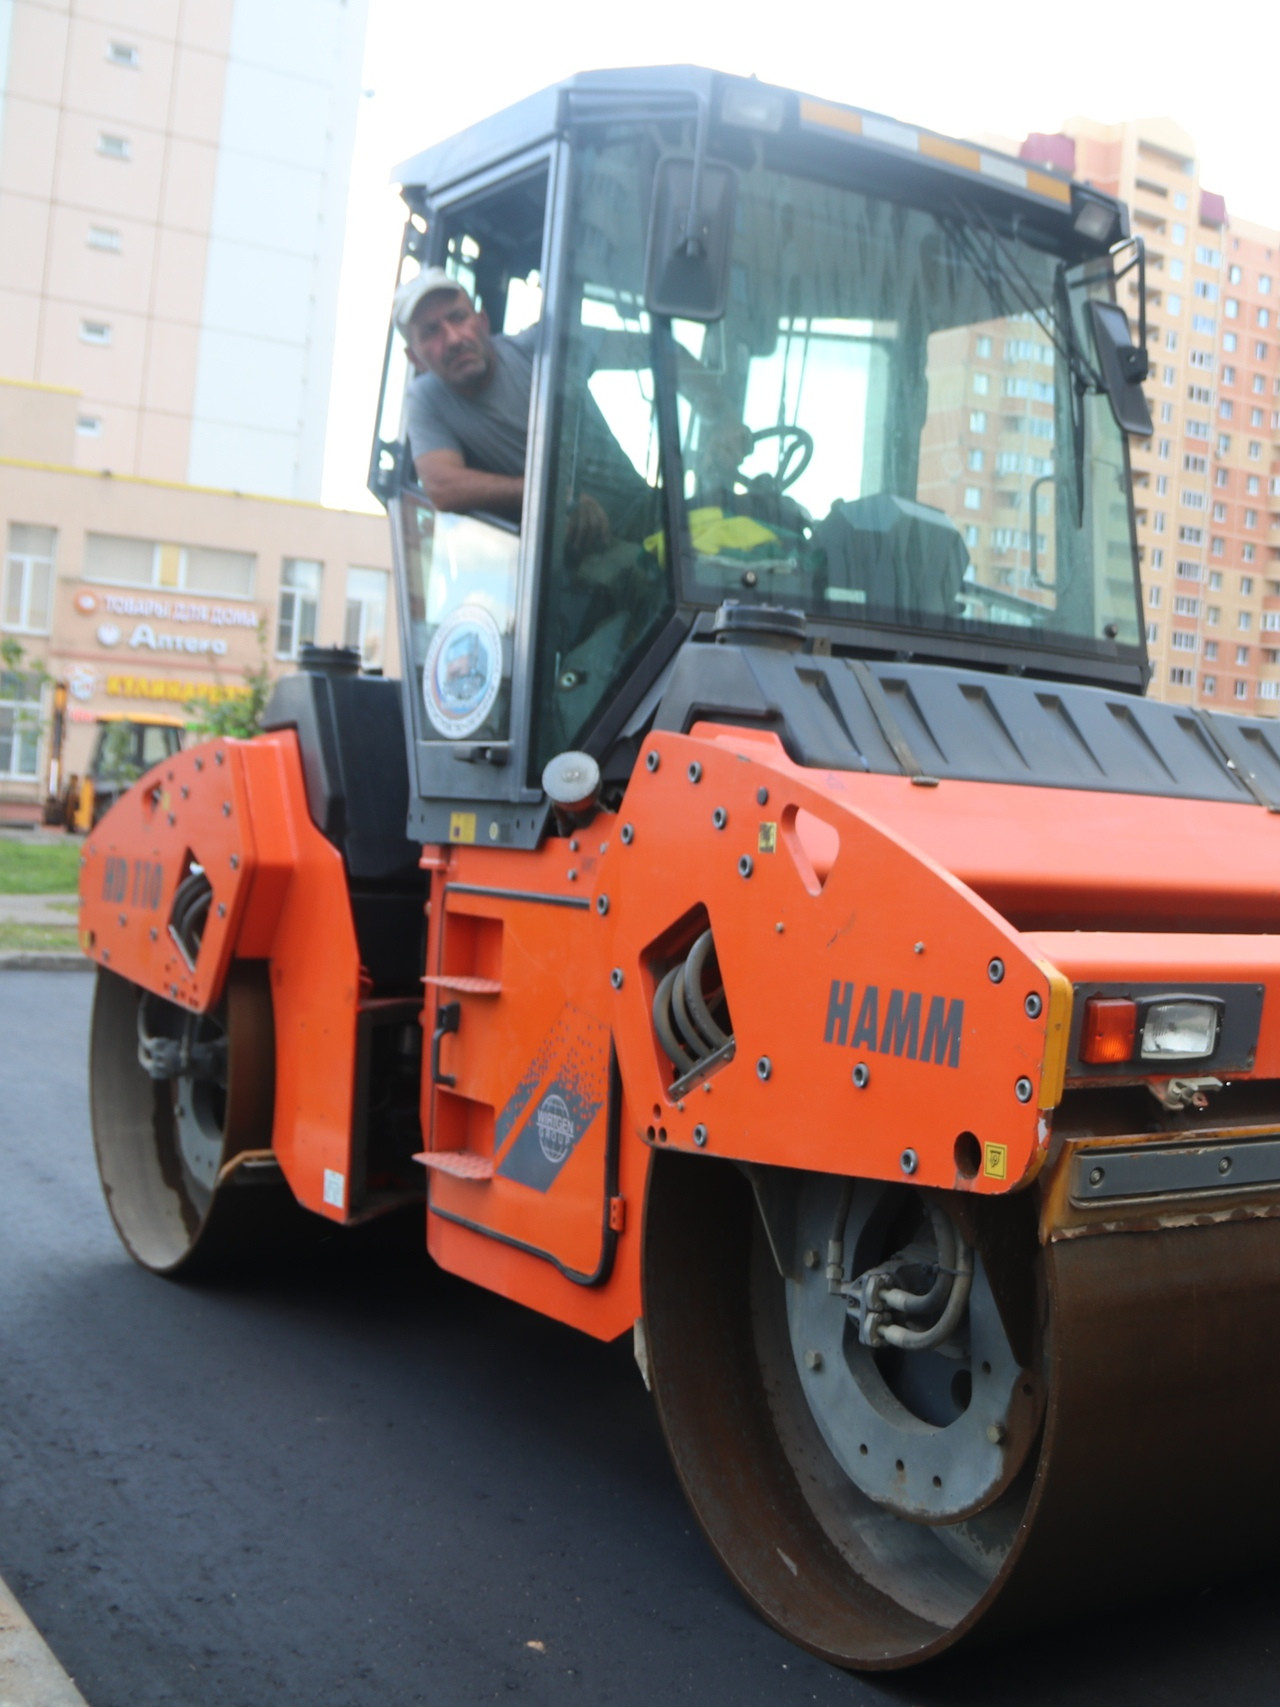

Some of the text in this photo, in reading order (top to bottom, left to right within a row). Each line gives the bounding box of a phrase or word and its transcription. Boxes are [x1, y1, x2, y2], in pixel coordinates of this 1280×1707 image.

[105, 594, 258, 628] ТОВАРЫ ДЛЯ ДОМА
[128, 623, 228, 655] Аптека
[824, 979, 965, 1069] HAMM
